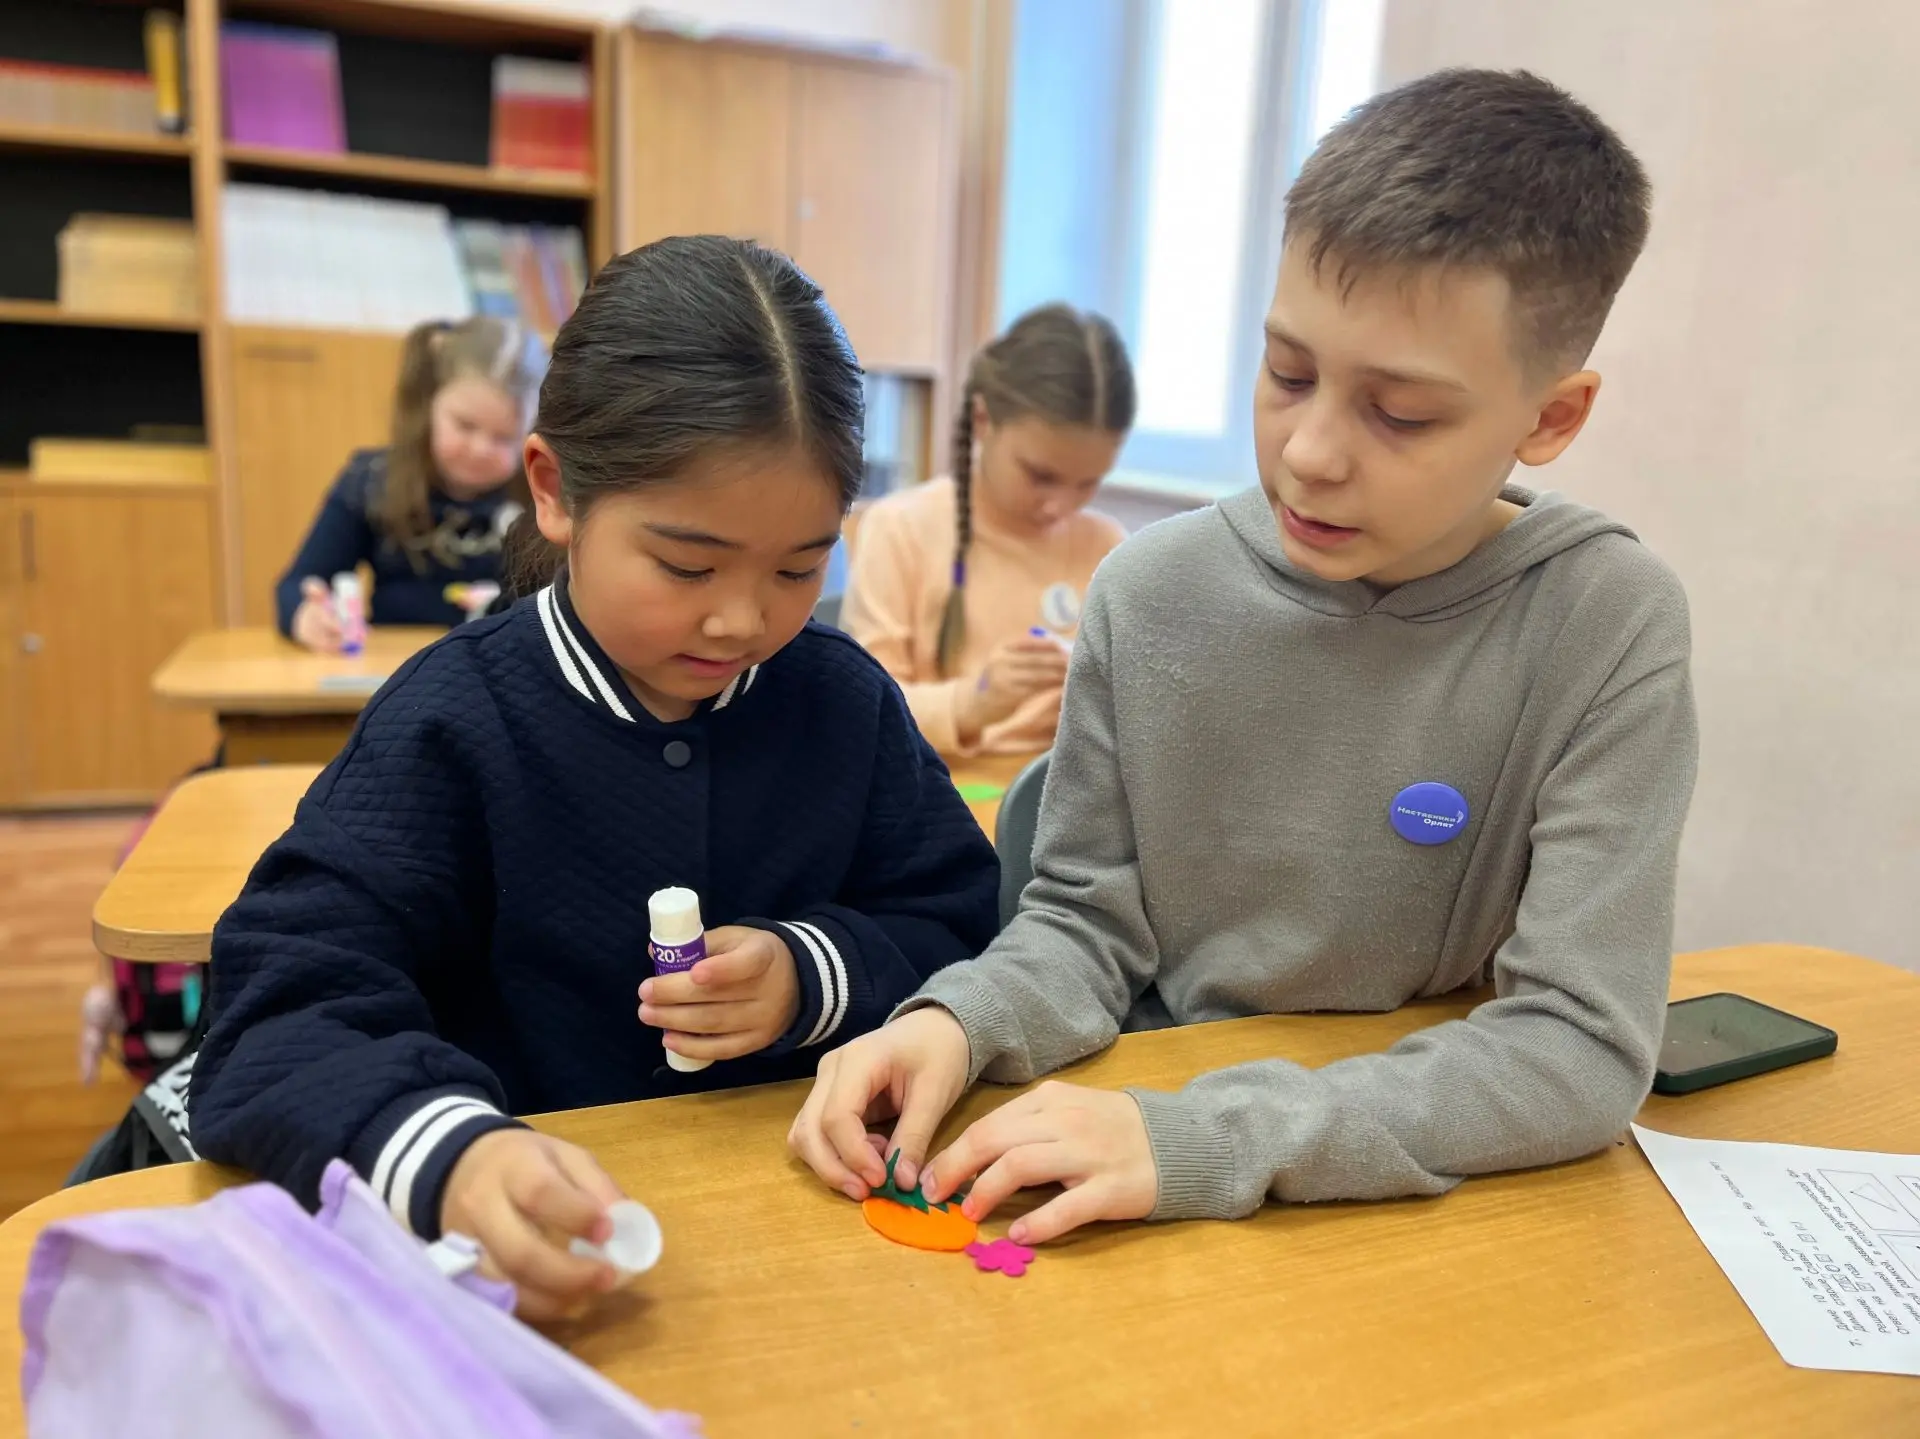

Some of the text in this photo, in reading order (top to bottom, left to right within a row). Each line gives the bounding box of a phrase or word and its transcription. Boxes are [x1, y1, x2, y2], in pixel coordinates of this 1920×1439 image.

[1423, 818, 1454, 829] Орлят
[1811, 1294, 1828, 1303] 10
[1817, 1278, 1846, 1307] старше
[1827, 1308, 1853, 1332] Диме
[1843, 1310, 1871, 1333] Дима
